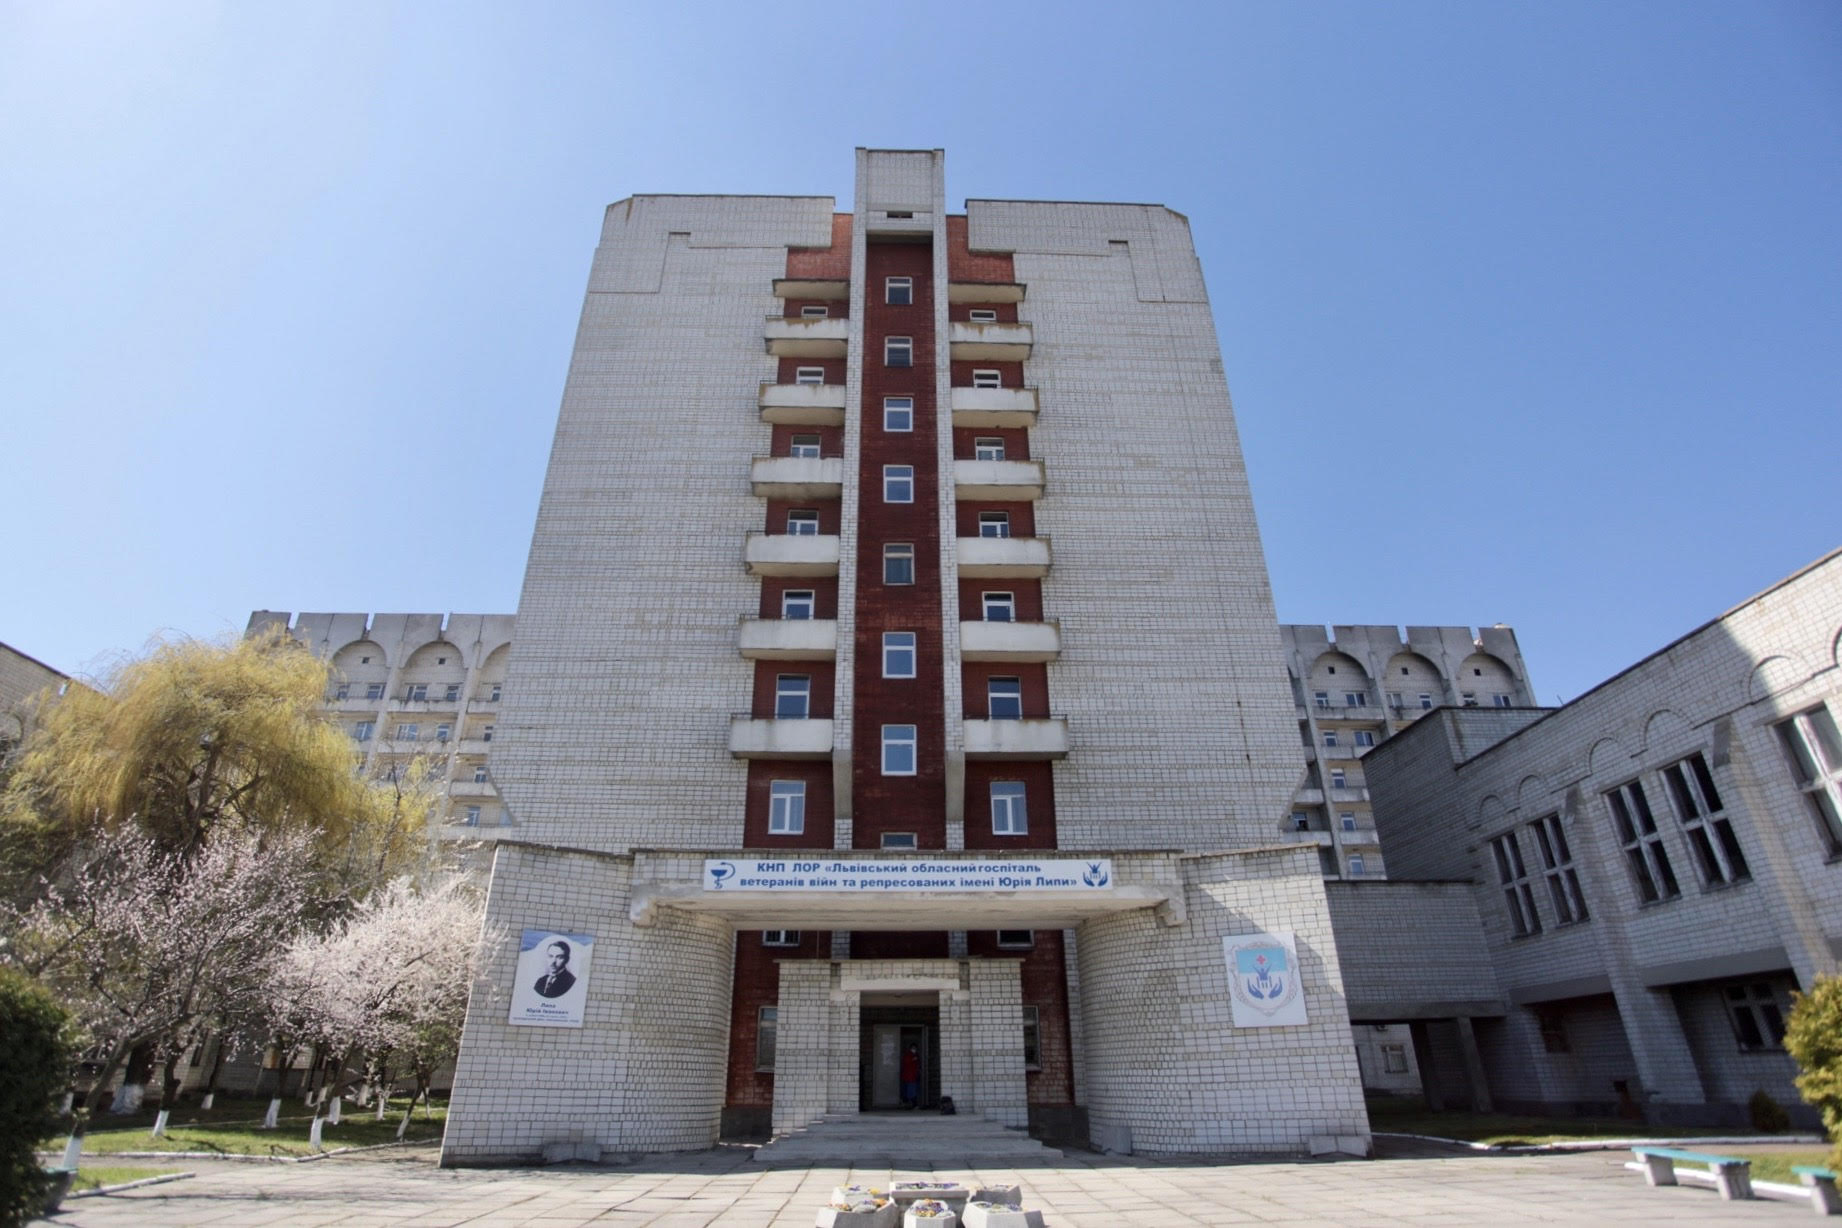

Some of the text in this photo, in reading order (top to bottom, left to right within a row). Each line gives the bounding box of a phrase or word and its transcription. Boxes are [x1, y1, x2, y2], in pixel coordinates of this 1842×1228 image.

[757, 863, 1041, 873] КНП ЛОР «Львівський обласний госпіталь
[740, 876, 1078, 889] ветеранів війн та репресованих імені Юрія Липи»
